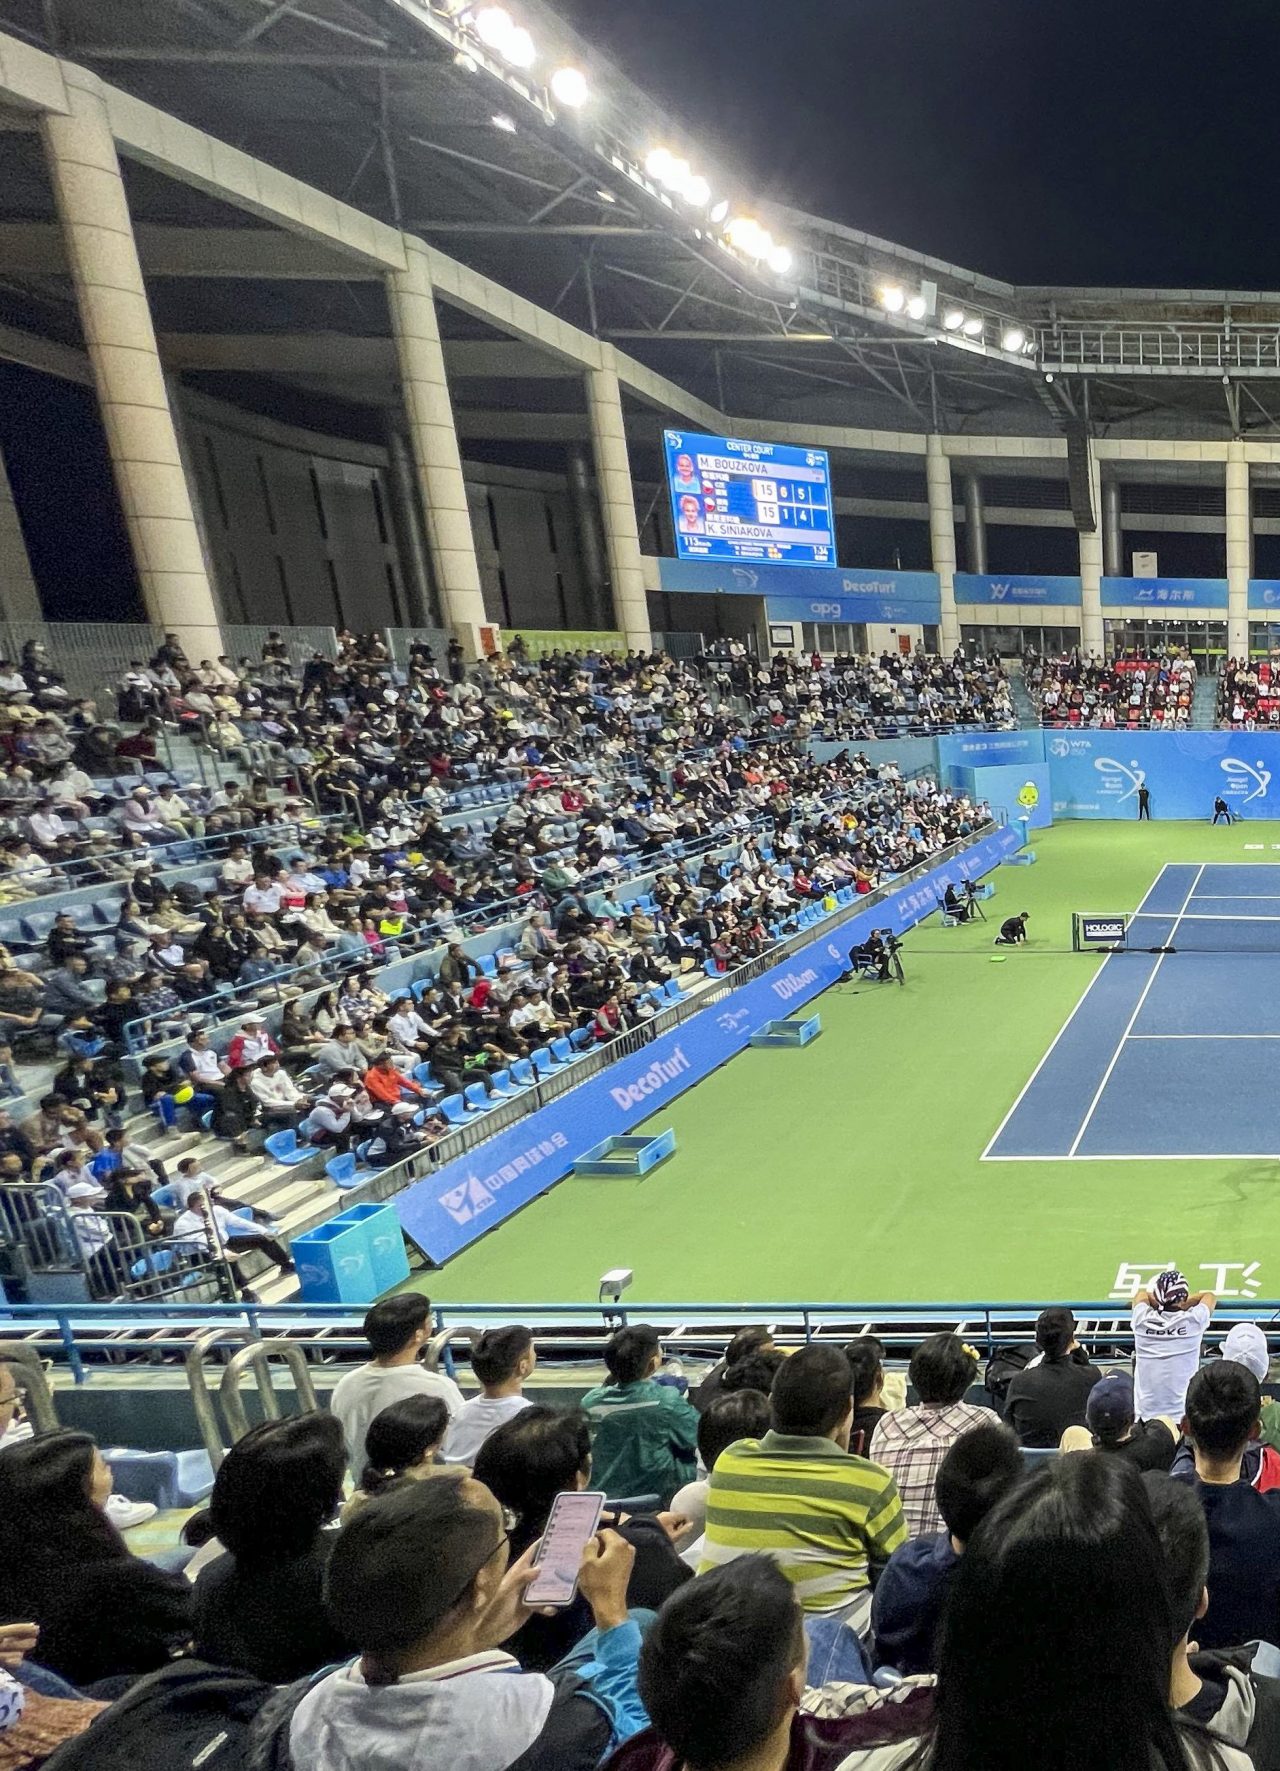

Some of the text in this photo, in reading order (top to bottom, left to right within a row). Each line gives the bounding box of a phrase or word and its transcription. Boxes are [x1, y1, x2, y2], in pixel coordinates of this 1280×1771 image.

[700, 457, 768, 474] M. BOUZKOVA
[760, 484, 773, 496] 15
[797, 487, 805, 500] 5
[763, 506, 775, 518] 15
[782, 508, 788, 520] 1
[800, 510, 807, 521] 4
[707, 524, 773, 538] K. SINIAKOVA
[842, 579, 896, 594] DecoTurf
[810, 602, 841, 618] apg
[1085, 923, 1123, 932] HOLOGIC
[608, 1043, 692, 1112] DecoTurf
